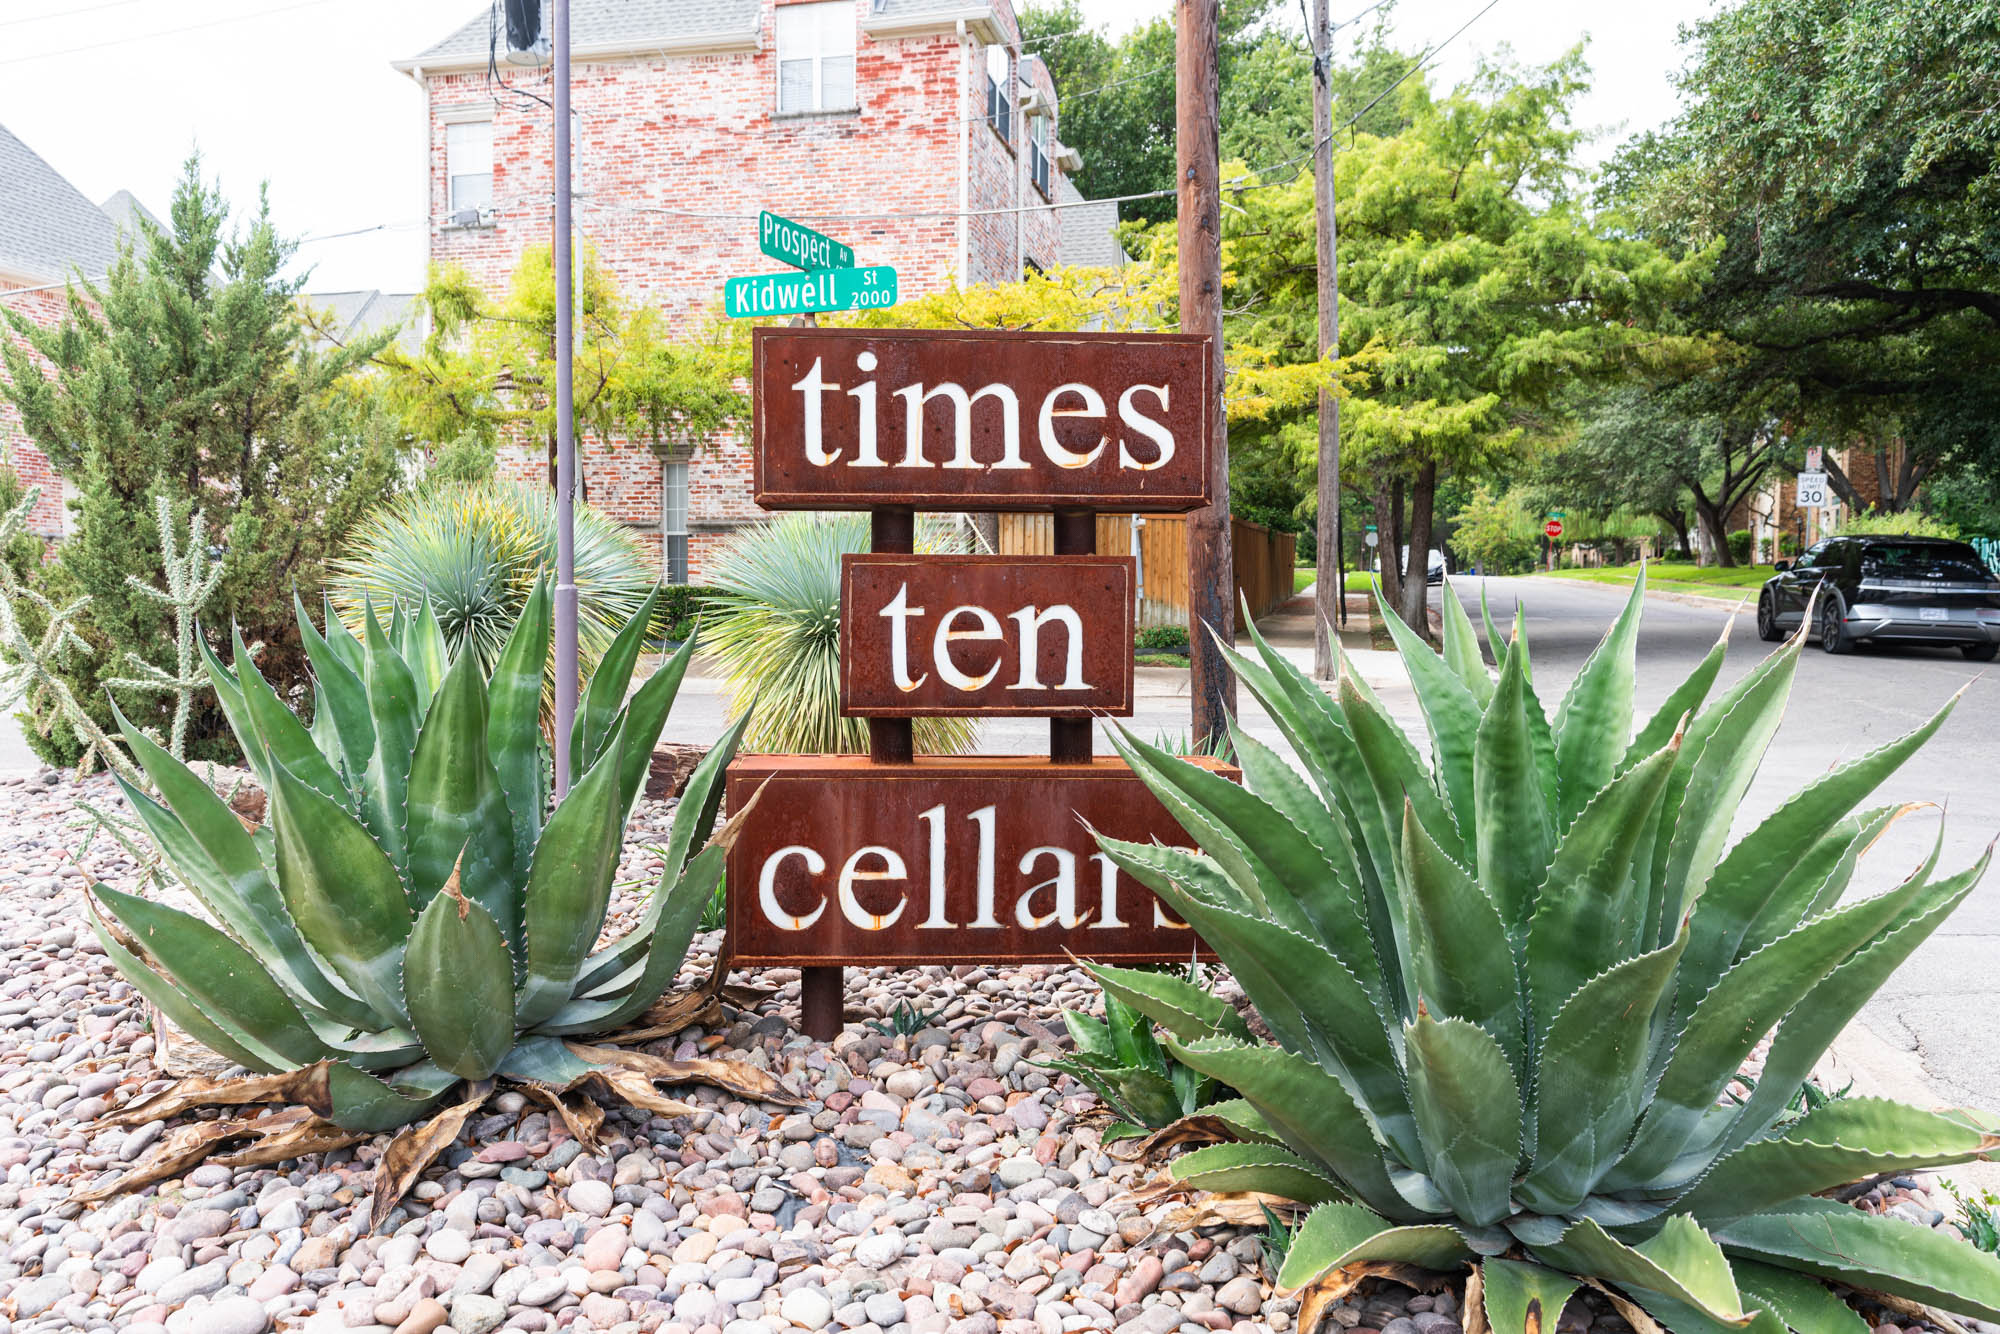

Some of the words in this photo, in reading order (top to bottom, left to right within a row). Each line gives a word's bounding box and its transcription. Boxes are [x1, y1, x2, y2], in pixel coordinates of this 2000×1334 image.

[763, 213, 831, 268] Prospect
[839, 247, 848, 262] Av
[735, 273, 838, 313] Kidwell
[863, 270, 878, 286] St
[849, 290, 891, 309] 2000
[792, 352, 1176, 470] times
[1800, 490, 1822, 503] 30
[1546, 524, 1562, 533] STOP
[879, 581, 1093, 691] ten
[758, 804, 1204, 931] cellar
